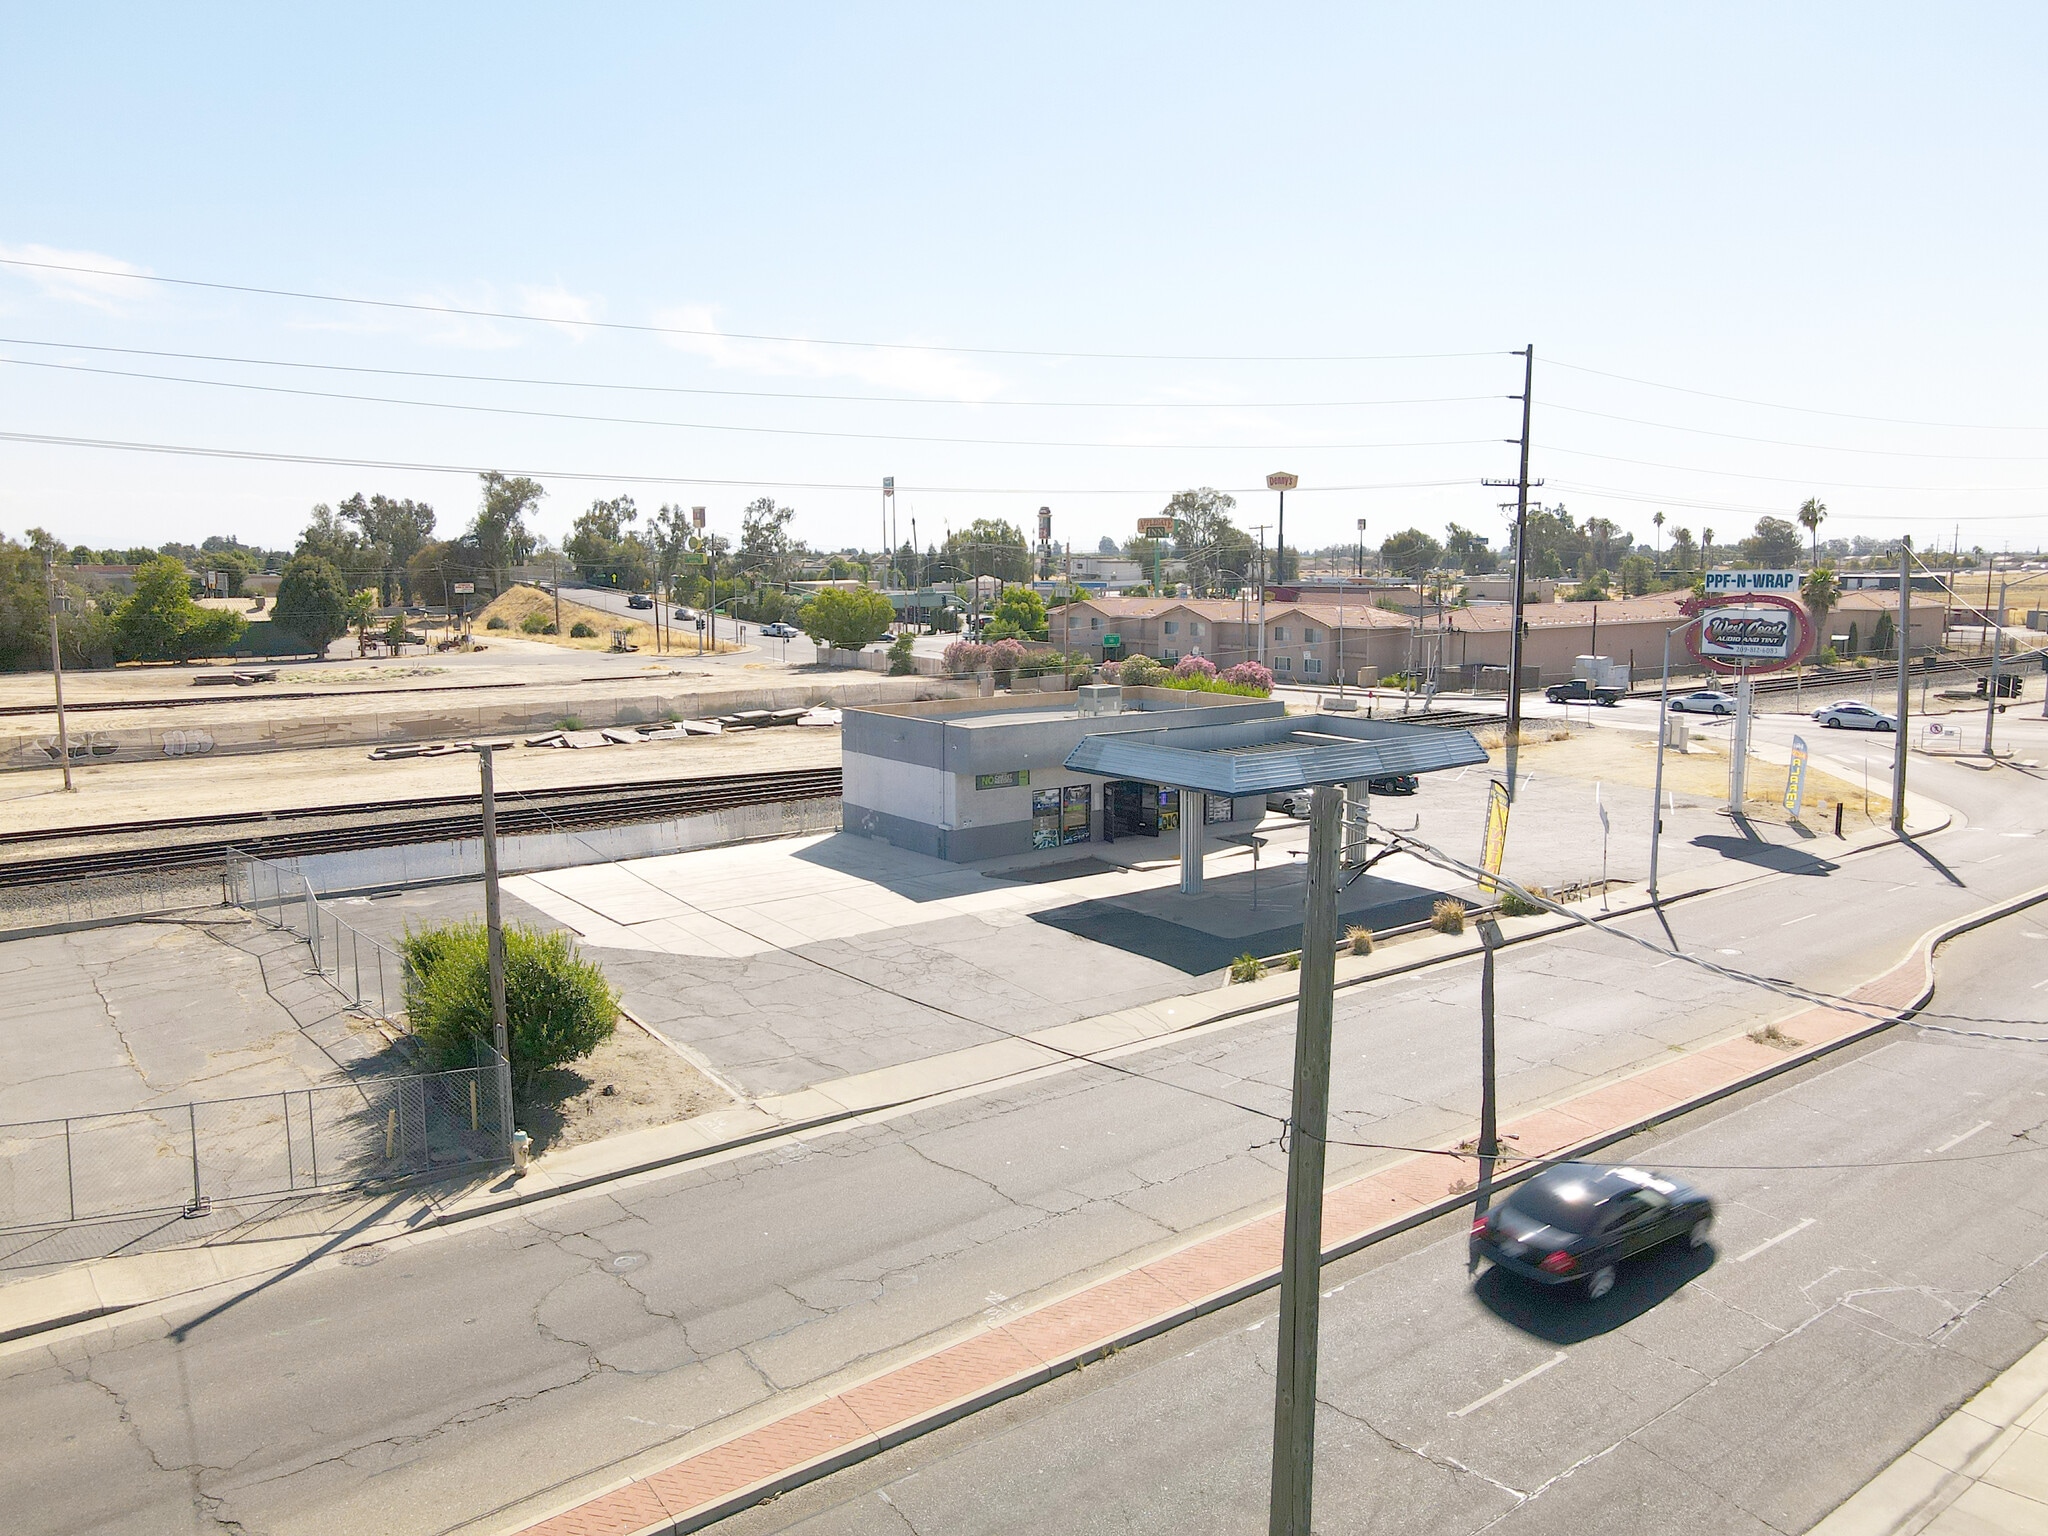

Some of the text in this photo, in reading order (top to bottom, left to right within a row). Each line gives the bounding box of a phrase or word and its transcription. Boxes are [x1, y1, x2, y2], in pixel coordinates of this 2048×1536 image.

[1269, 475, 1293, 486] Denny's
[1147, 527, 1165, 537] INN
[1706, 573, 1794, 588] PPF-N-WRAP
[1712, 620, 1785, 636] West Coast
[1742, 635, 1760, 643] AND
[981, 776, 995, 785] NO
